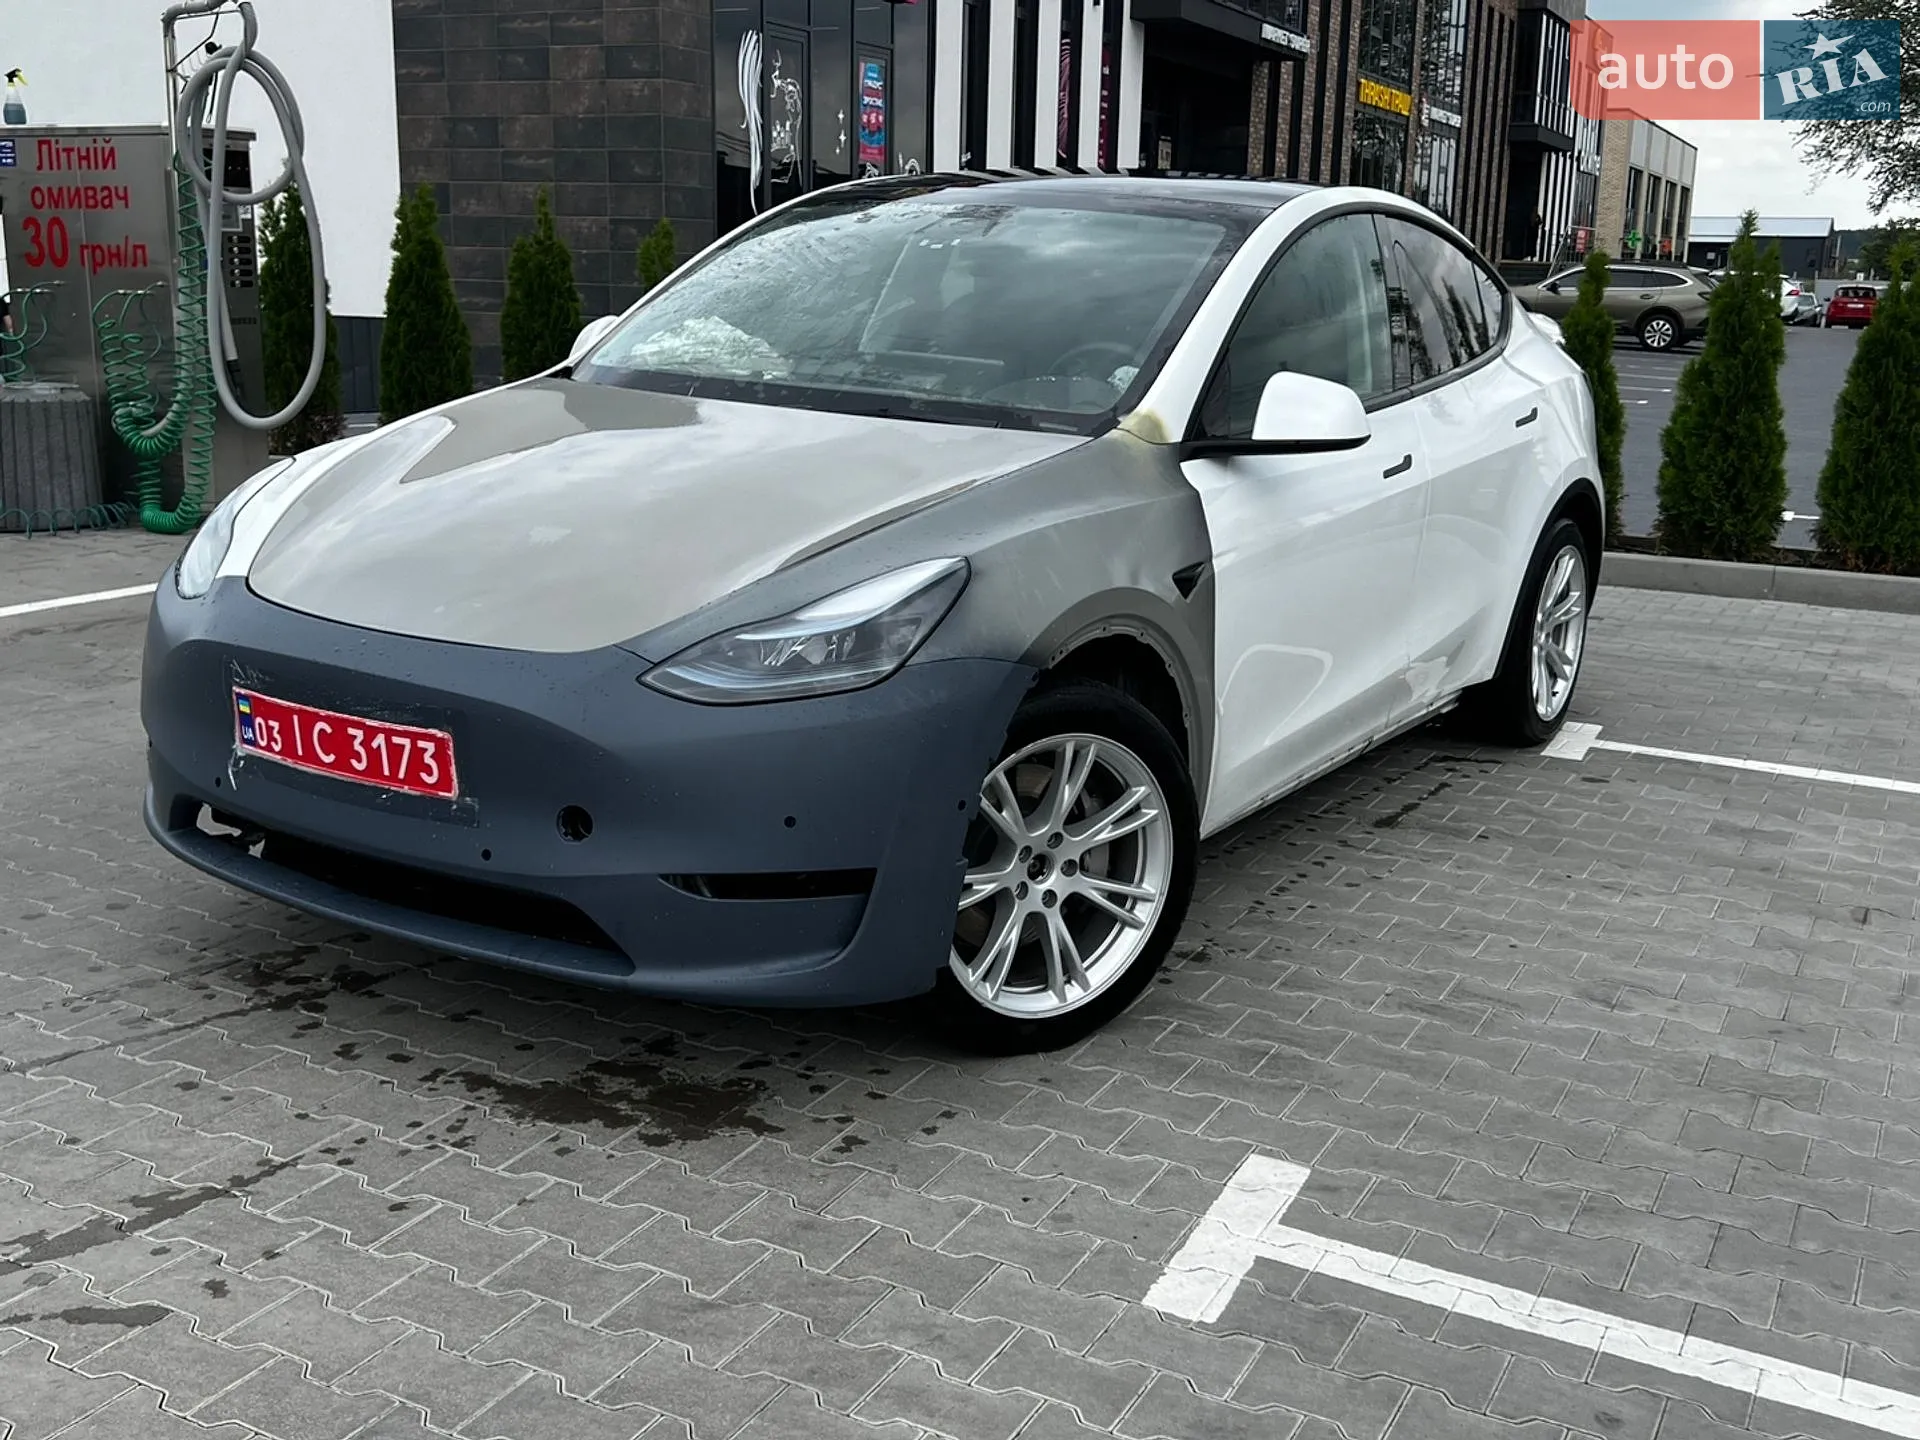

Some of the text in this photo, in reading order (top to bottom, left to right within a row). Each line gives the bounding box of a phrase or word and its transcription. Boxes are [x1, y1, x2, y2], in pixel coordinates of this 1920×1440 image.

[36, 138, 116, 171] Літній
[30, 185, 129, 210] омивач
[22, 216, 148, 276] 30 грн/л
[242, 725, 255, 741] UA
[254, 716, 282, 752] 03
[347, 726, 440, 784] 3173
